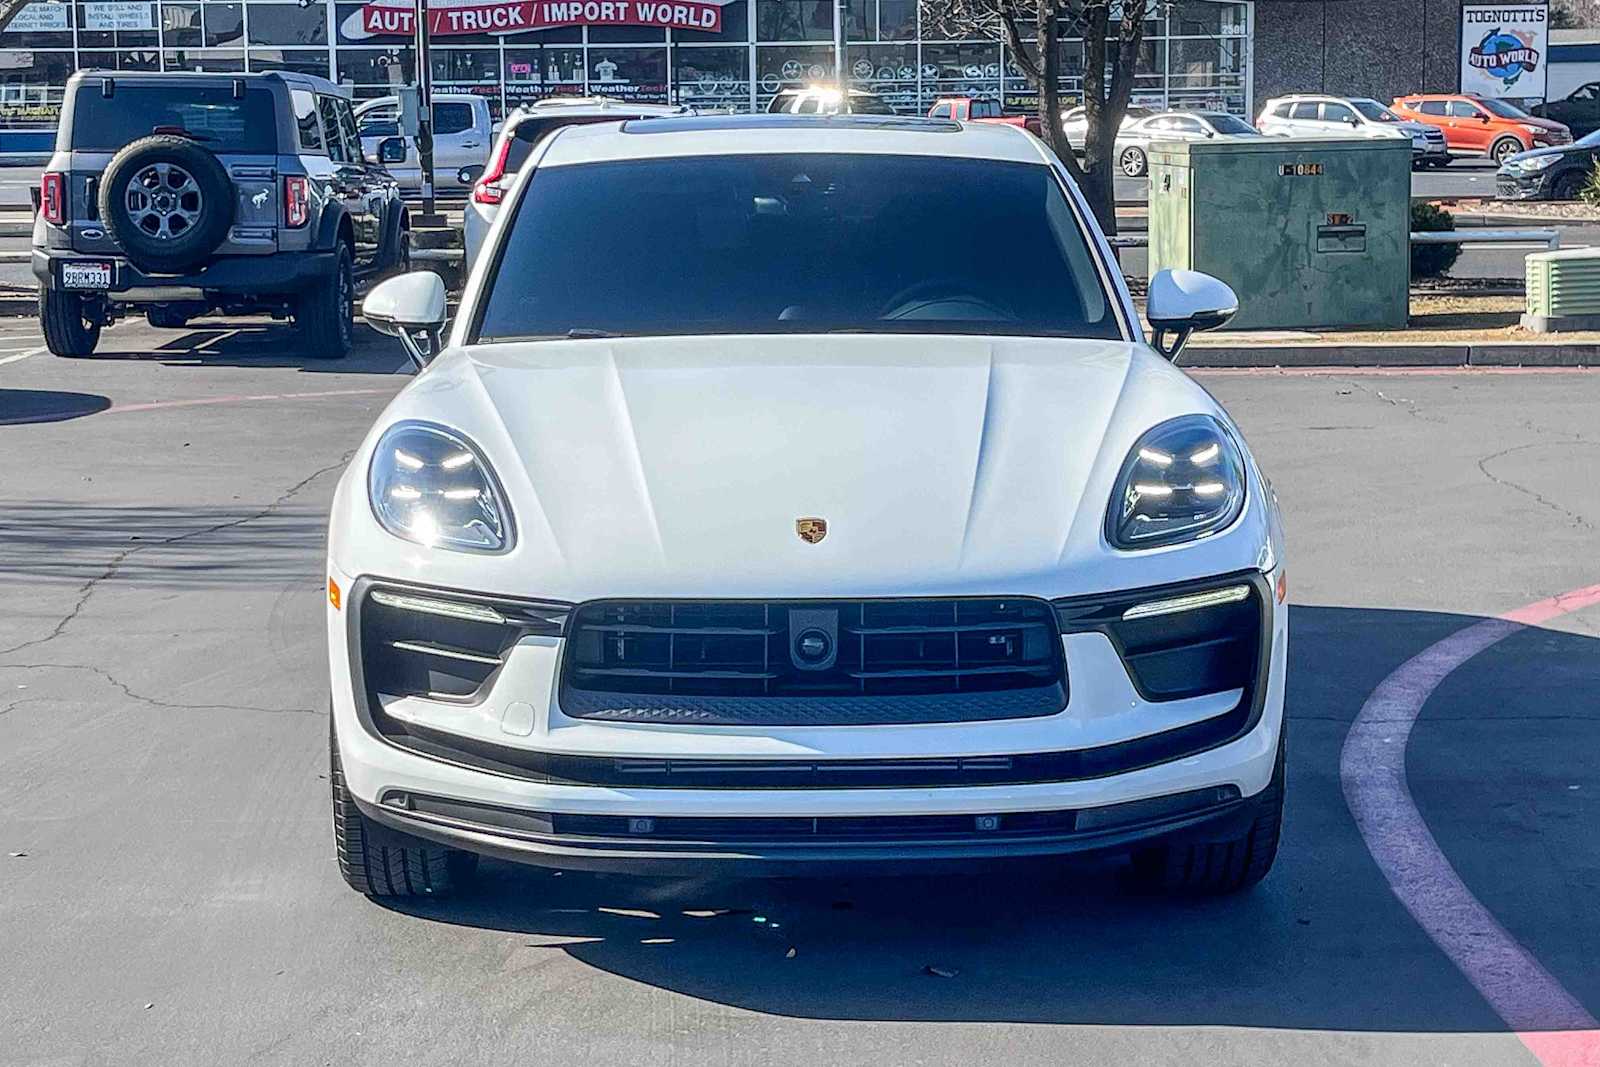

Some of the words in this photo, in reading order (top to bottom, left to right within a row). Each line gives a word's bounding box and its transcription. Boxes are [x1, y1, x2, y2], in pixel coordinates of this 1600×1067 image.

[368, 11, 417, 32] AUT
[448, 7, 524, 31] TRUCK
[543, 1, 629, 22] IMPORT
[636, 3, 716, 28] WORLD
[1466, 7, 1545, 23] TOGNOTTI'S
[1470, 52, 1497, 67] AUTO
[1499, 48, 1537, 65] WORLD
